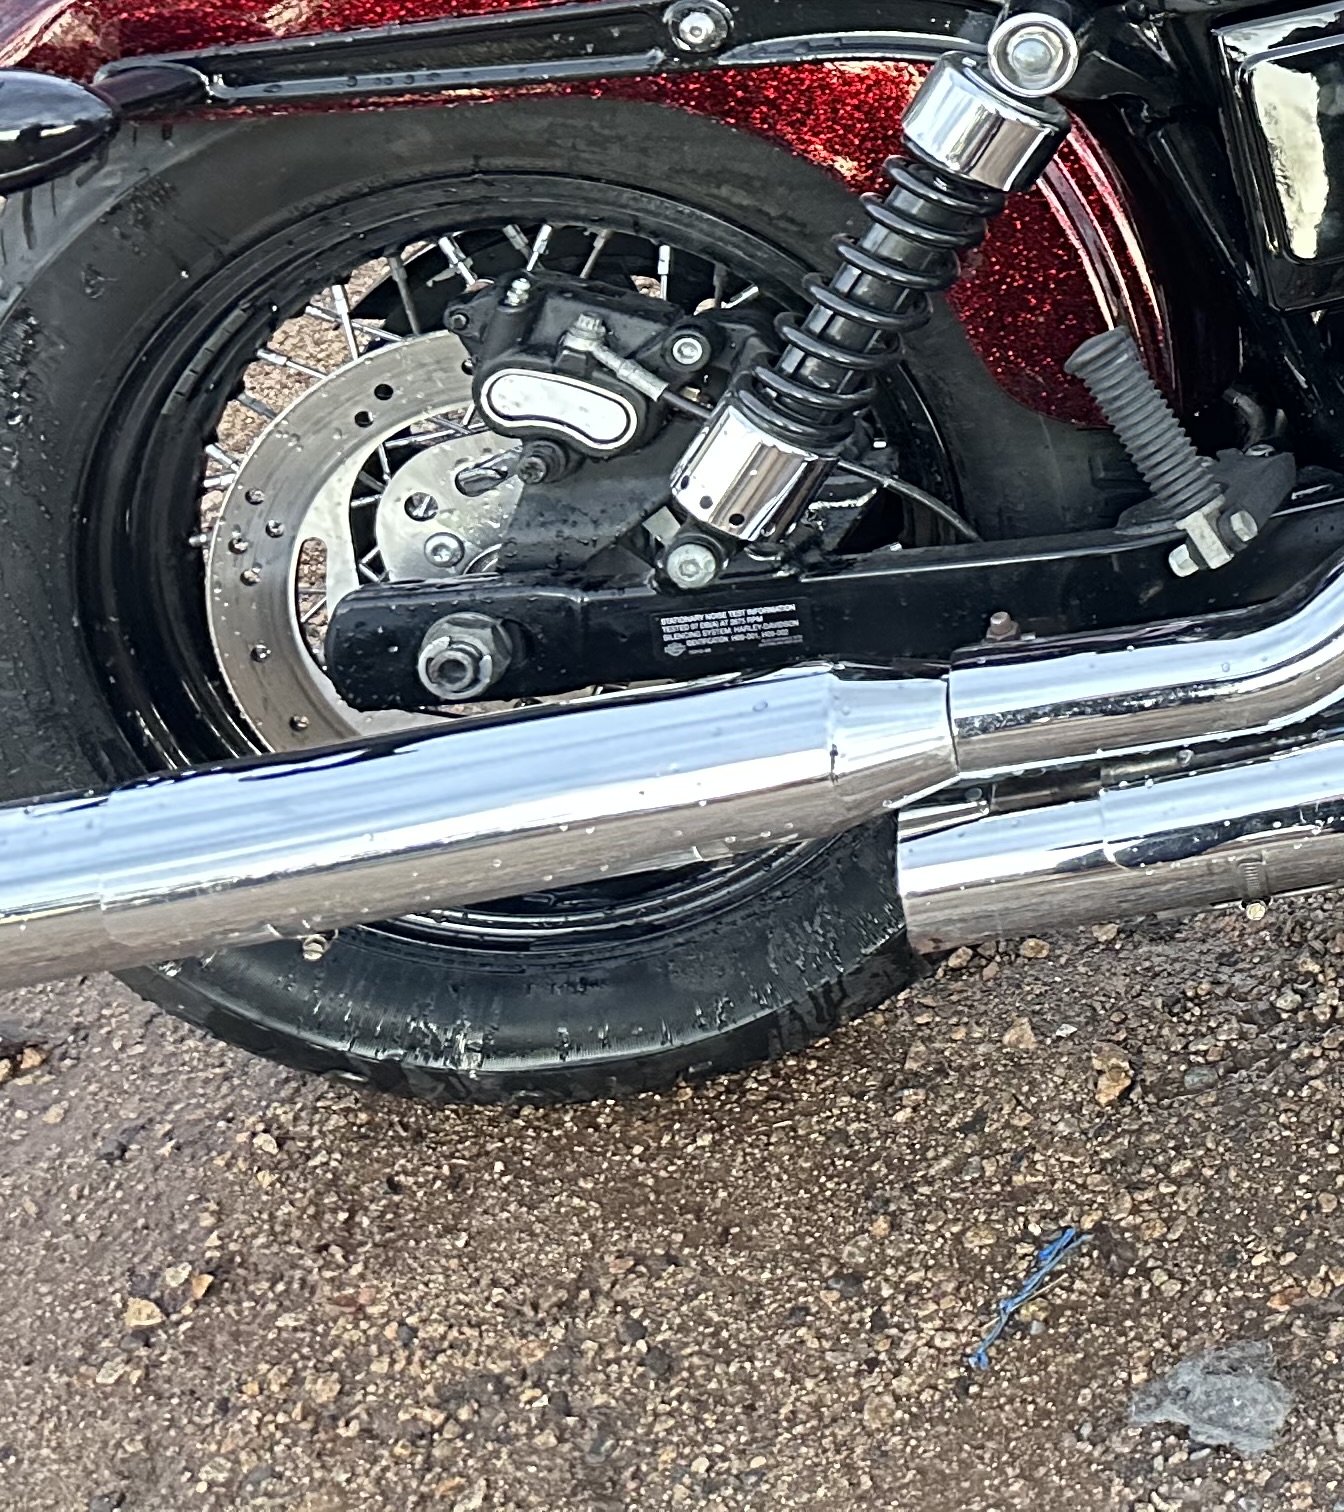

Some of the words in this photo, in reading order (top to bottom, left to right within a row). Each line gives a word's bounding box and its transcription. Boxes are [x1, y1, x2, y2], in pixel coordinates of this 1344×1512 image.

[705, 611, 727, 620] NOISE
[728, 609, 745, 617] TEST
[746, 603, 796, 615] INFORMATION
